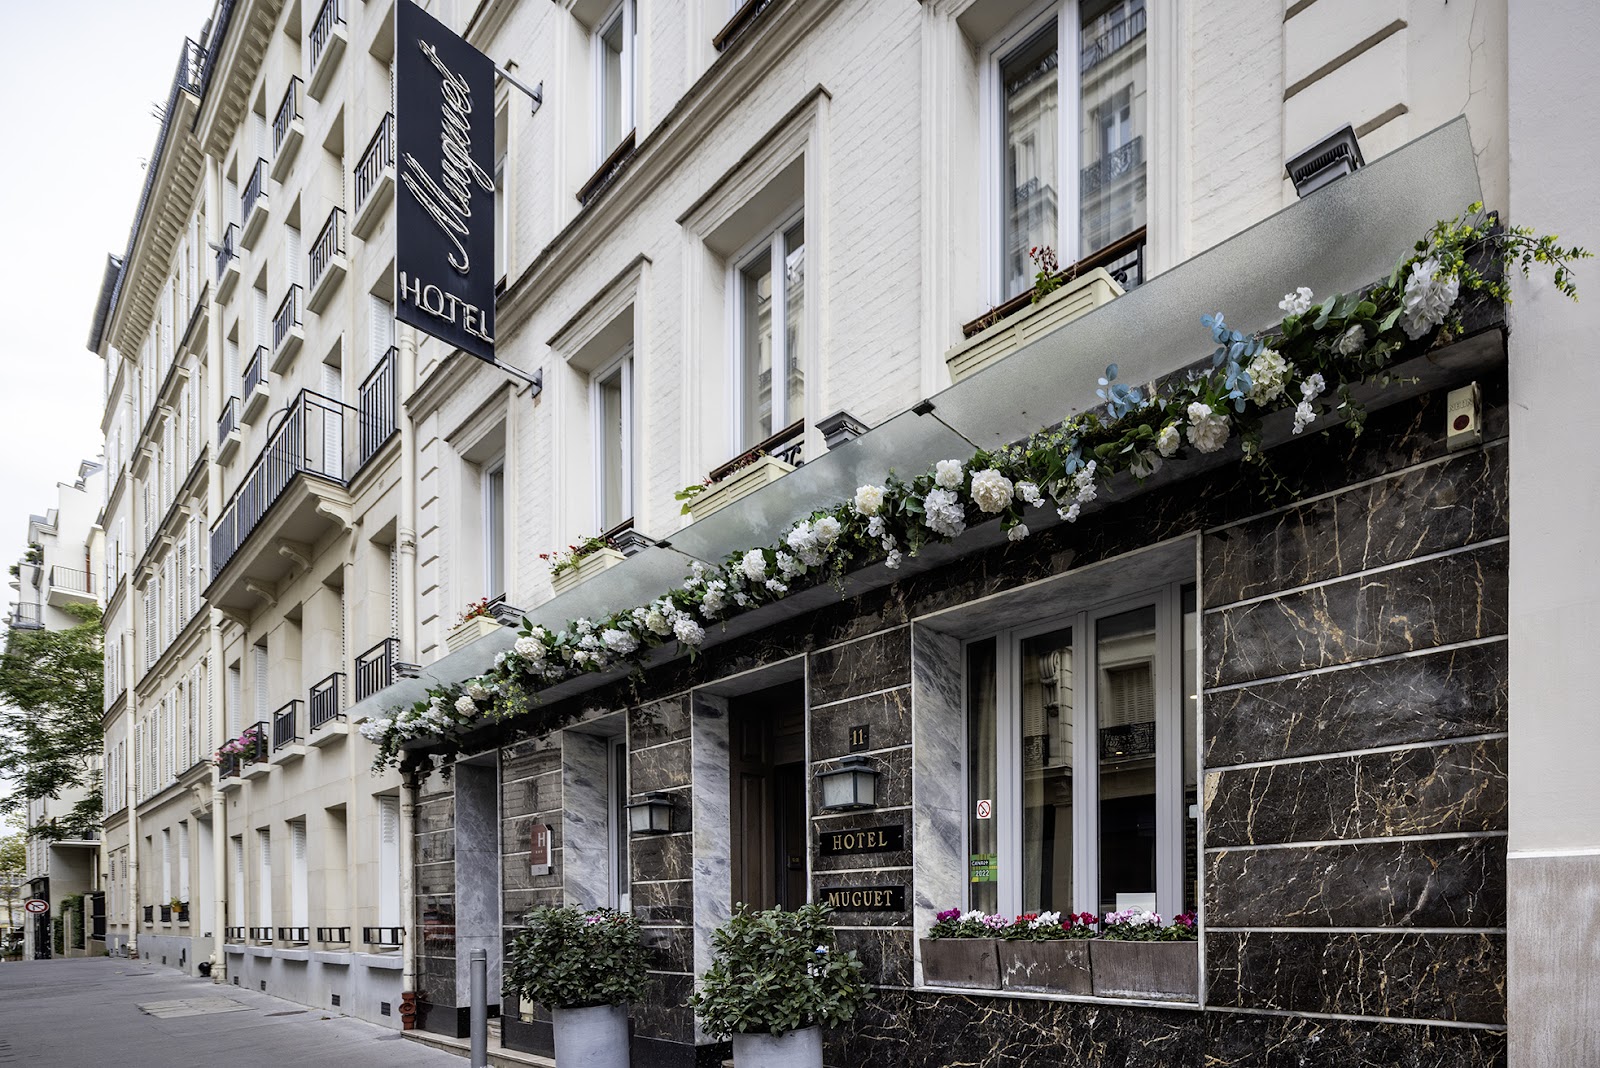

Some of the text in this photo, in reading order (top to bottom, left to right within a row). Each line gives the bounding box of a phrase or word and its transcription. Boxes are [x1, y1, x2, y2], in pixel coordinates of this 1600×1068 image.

[401, 38, 495, 274] Muguet
[399, 270, 495, 344] HOTEL
[852, 728, 864, 746] 11
[537, 831, 546, 848] H
[832, 831, 888, 851] HOTEL
[975, 869, 990, 877] 2022
[828, 890, 893, 907] MUGUET
